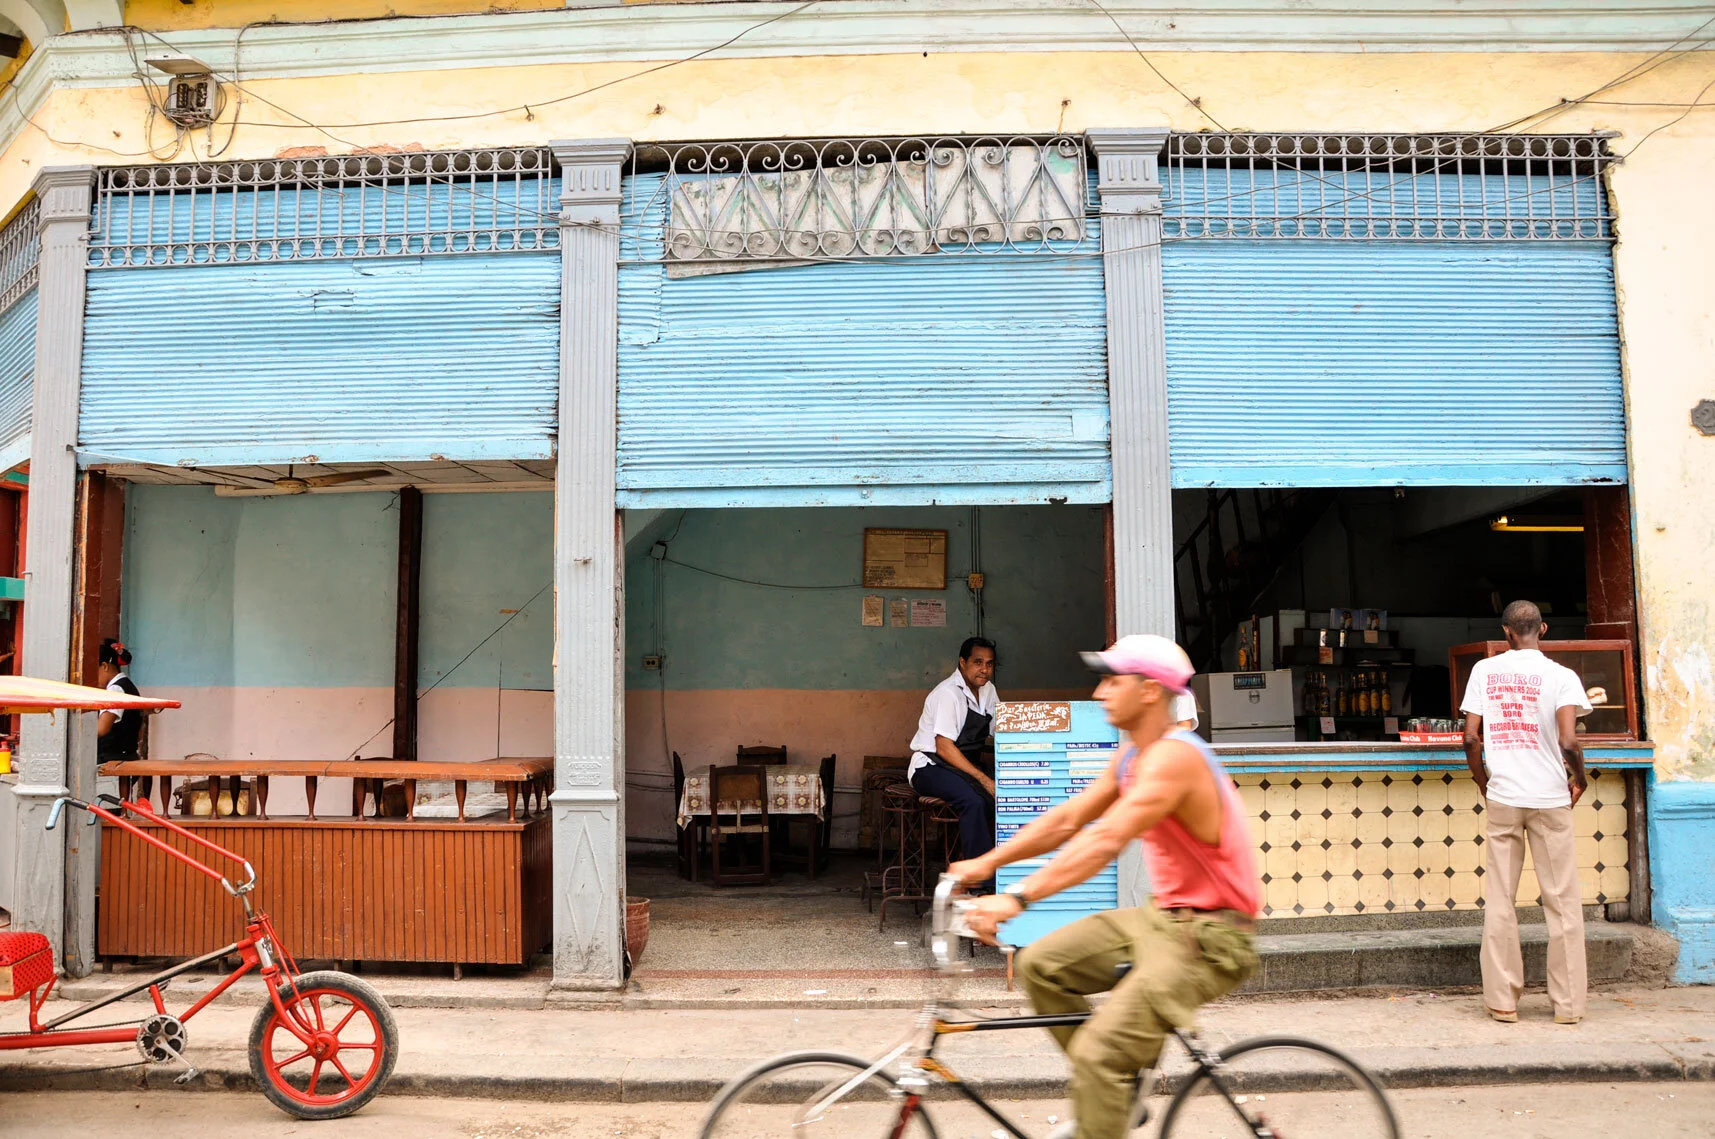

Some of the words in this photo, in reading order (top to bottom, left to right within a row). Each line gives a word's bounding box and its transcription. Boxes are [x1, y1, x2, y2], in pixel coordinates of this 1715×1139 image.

[1487, 674, 1542, 686] BORO
[1498, 685, 1525, 693] WINNERS
[1526, 687, 1541, 695] 2004
[1501, 702, 1523, 710] SUPER
[1503, 710, 1522, 718] BORO
[1490, 722, 1511, 731] RECORD
